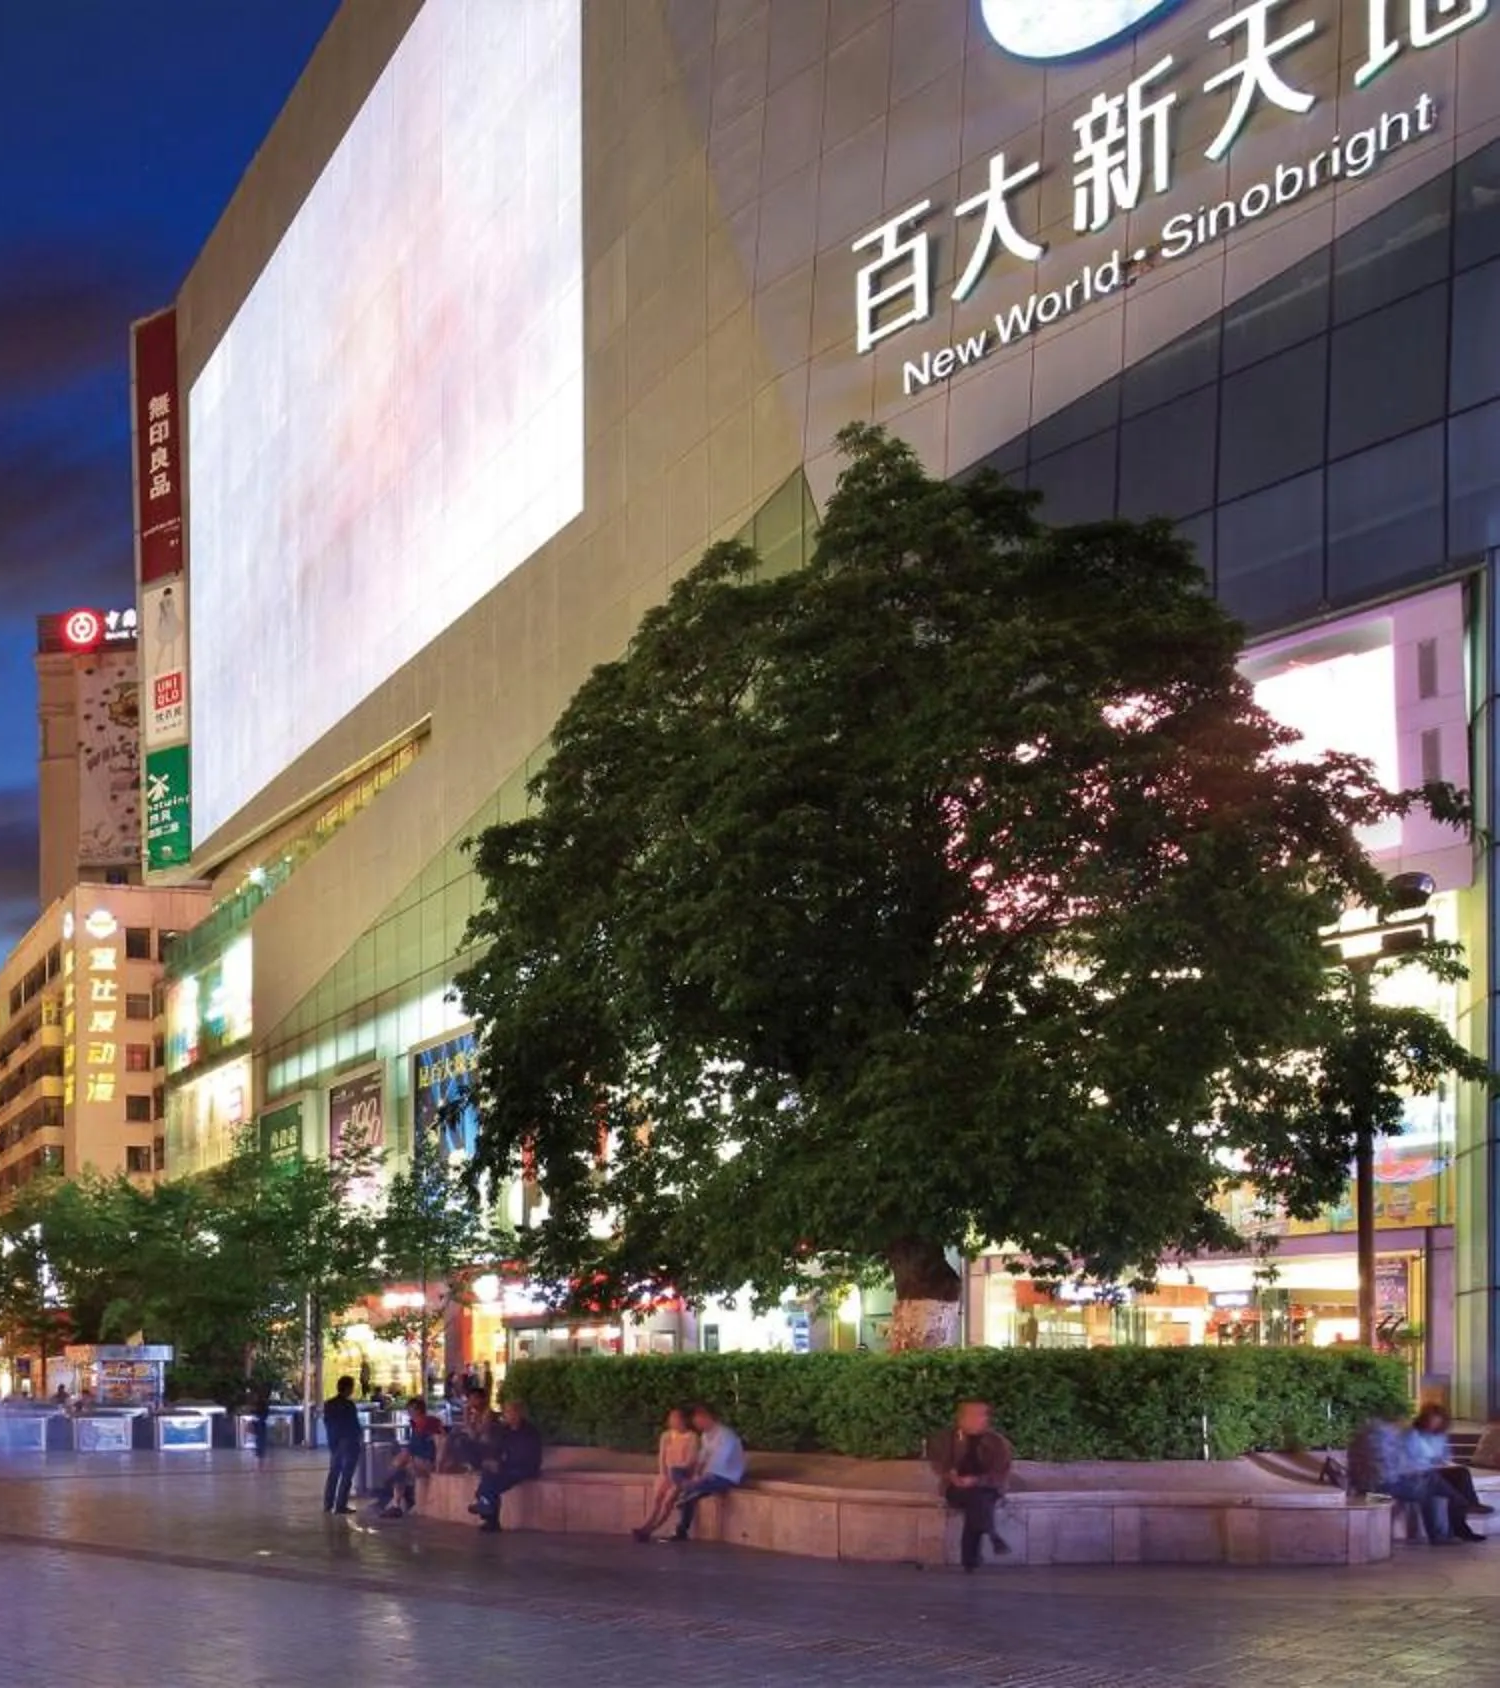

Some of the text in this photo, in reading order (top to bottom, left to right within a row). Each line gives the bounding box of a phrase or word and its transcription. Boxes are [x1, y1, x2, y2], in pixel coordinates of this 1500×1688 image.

[903, 331, 986, 395] New
[995, 249, 1120, 344] World
[1161, 94, 1433, 258] Sinobright
[149, 392, 171, 500] 無印良品
